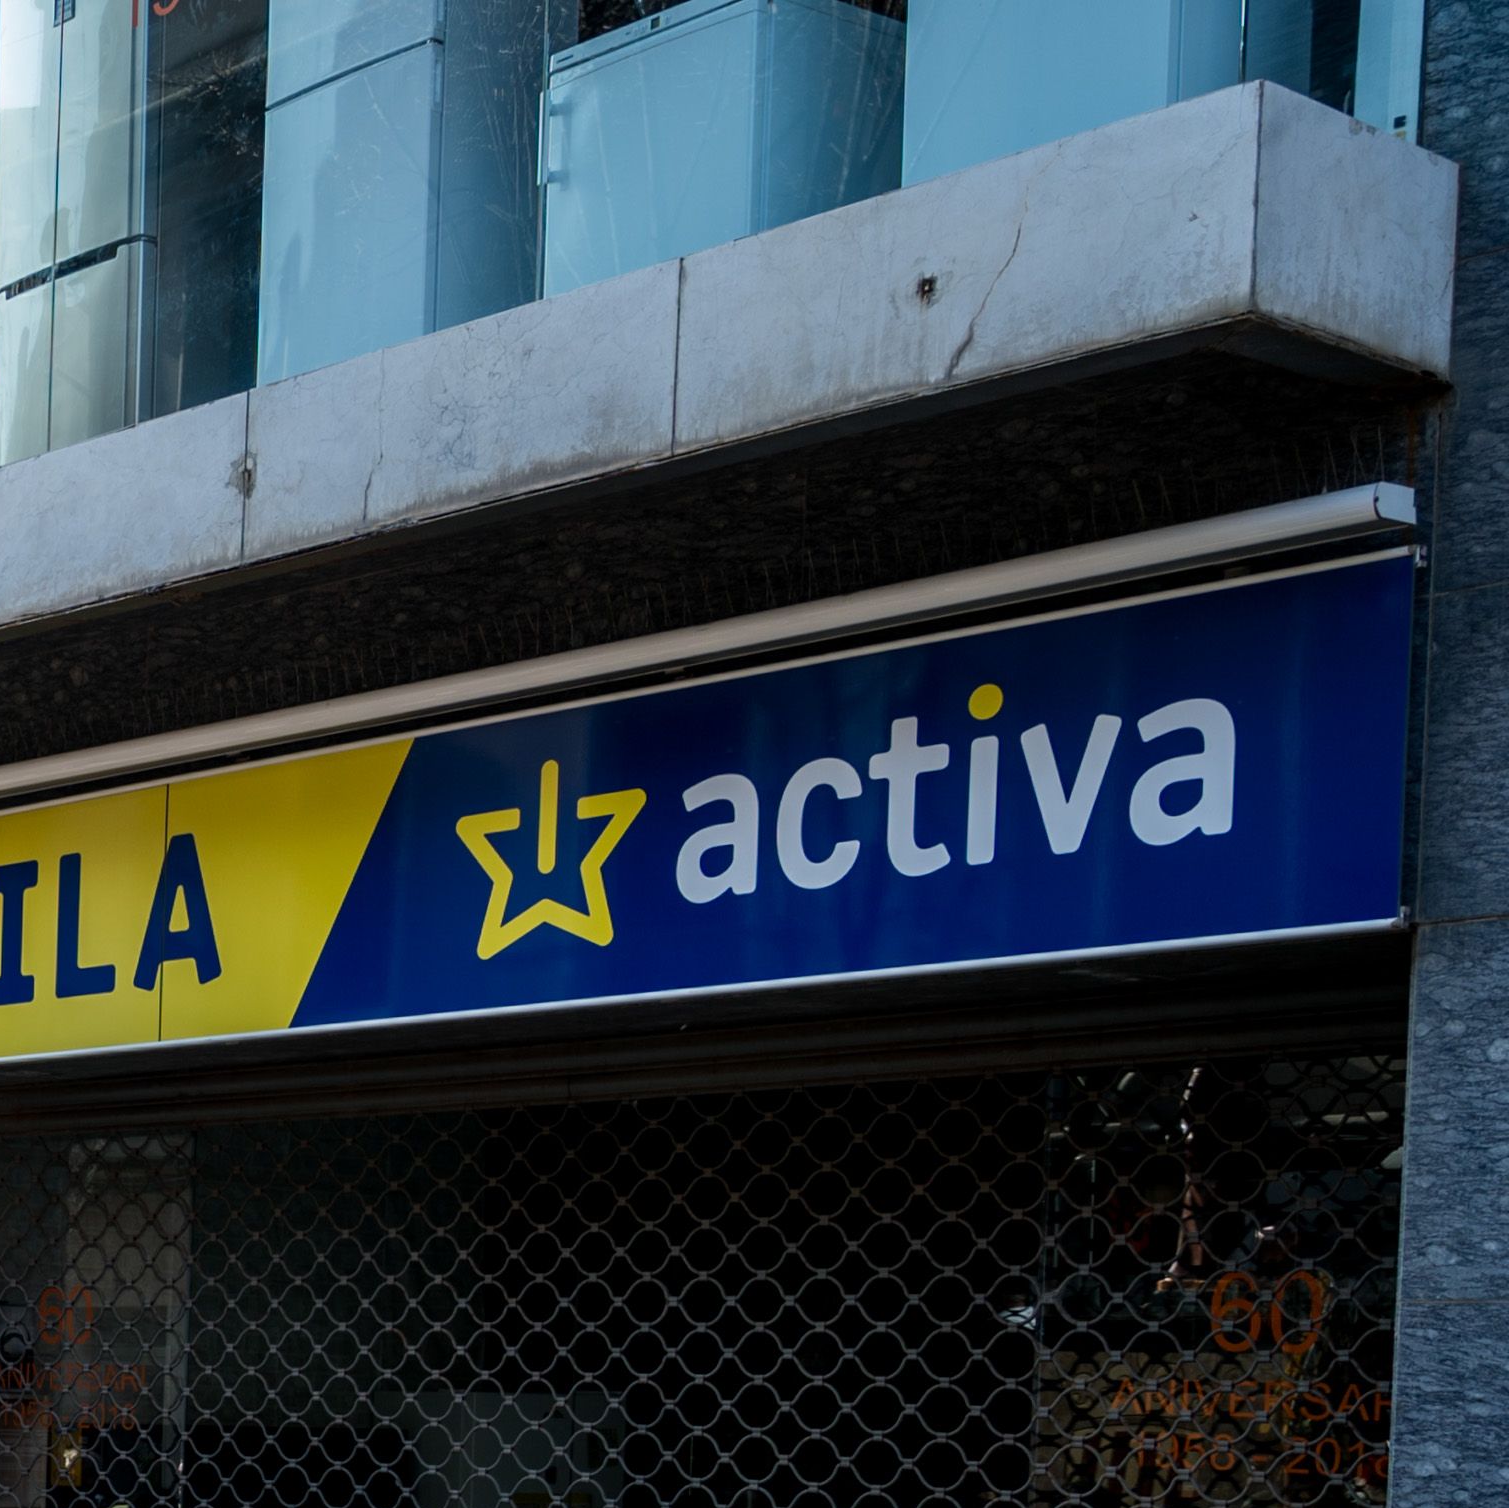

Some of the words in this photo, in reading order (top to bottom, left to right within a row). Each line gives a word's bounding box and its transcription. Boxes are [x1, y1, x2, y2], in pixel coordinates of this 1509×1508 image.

[676, 683, 1237, 905] activa
[37, 1285, 94, 1345] 60
[1210, 1270, 1322, 1354] 60
